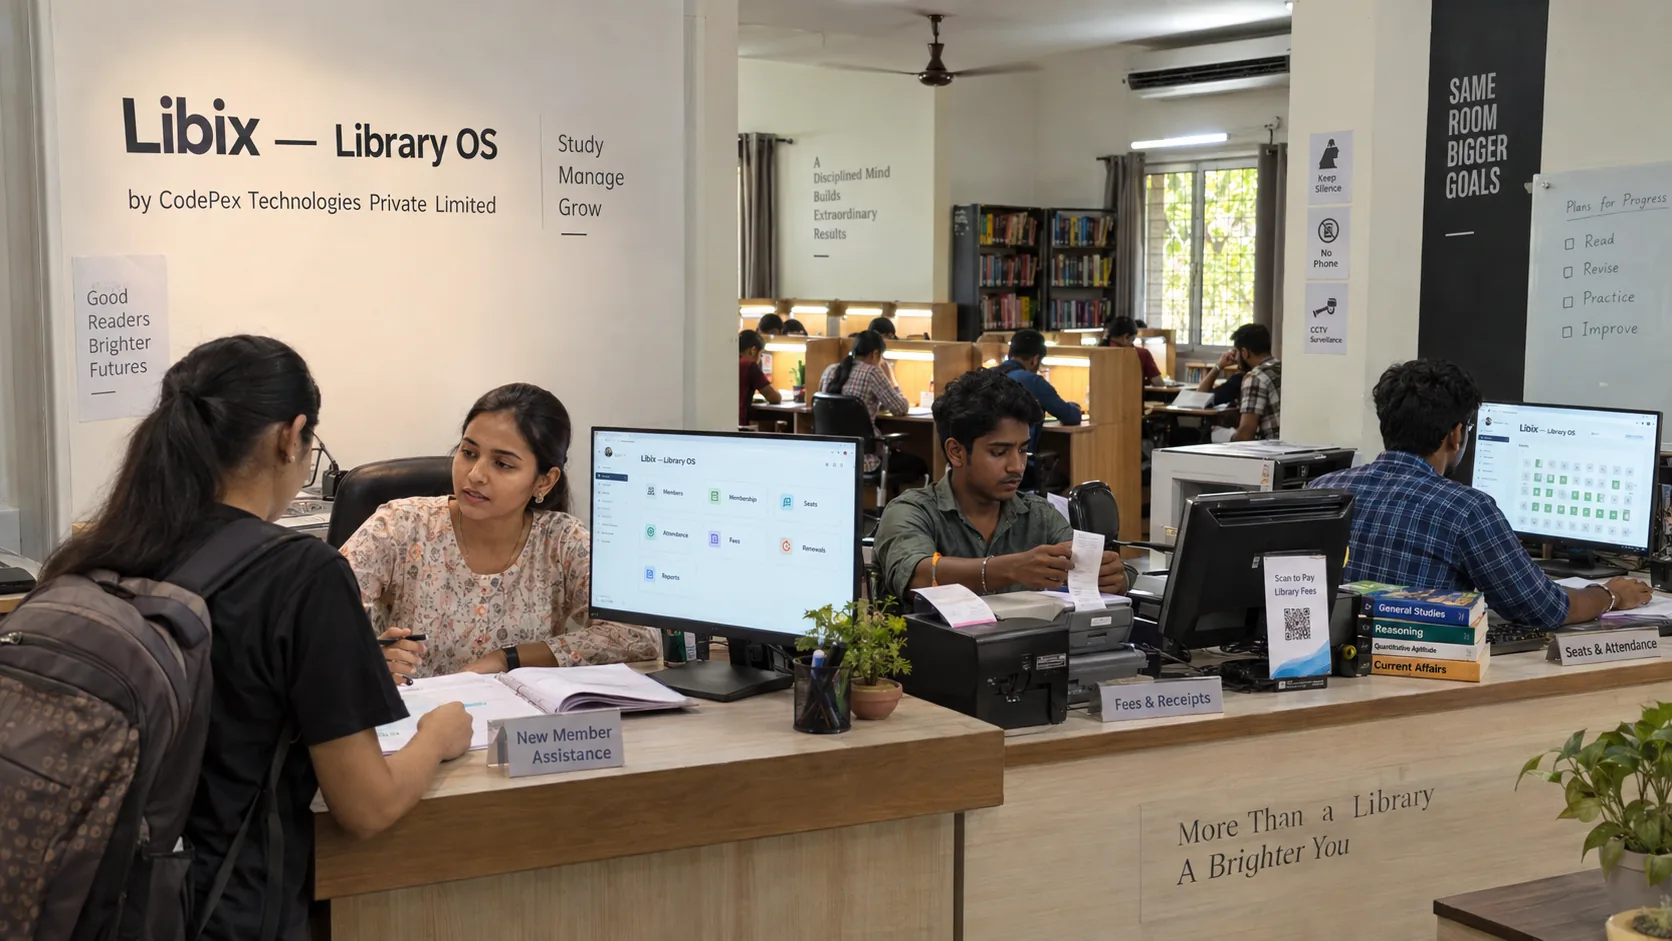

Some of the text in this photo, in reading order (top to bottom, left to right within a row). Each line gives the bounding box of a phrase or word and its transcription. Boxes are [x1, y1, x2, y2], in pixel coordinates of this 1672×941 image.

[1449, 72, 1497, 105] SAME
[1448, 103, 1498, 136] ROOM
[122, 95, 261, 156] Libix
[335, 122, 448, 167] Library
[456, 128, 498, 160] OS
[558, 134, 604, 158] Study
[1447, 134, 1508, 168] BIGGER
[813, 156, 820, 168] A
[558, 165, 625, 190] Manage
[813, 165, 890, 184] Disciplined Mind
[1318, 174, 1337, 183] Keep
[1445, 166, 1501, 199] GOALS
[128, 188, 497, 214] by CodePex Technologies Private Limited
[813, 189, 841, 202] Builds
[1600, 196, 1616, 212] for
[1623, 193, 1668, 210] Progress
[558, 198, 602, 217] Grow
[813, 208, 878, 222] Extraordinary
[813, 228, 847, 240] Results
[1585, 233, 1615, 248] Read
[1320, 249, 1332, 257] No
[1313, 260, 1338, 268] Phone
[1583, 262, 1619, 276] Revise
[87, 288, 128, 306] Good
[1583, 290, 1635, 306] Practice
[88, 312, 150, 330] Readers
[1310, 326, 1328, 334] CCTV
[1582, 321, 1638, 341] Improve
[89, 336, 151, 356] Brighter
[90, 361, 148, 378] Futures
[1519, 424, 1539, 433] Libix
[641, 455, 657, 463] Libix
[663, 457, 685, 466] Library
[686, 458, 696, 466] OS
[803, 500, 818, 508] Seats
[1274, 574, 1292, 582] Scan
[1302, 573, 1315, 583] Pay
[1274, 587, 1317, 597] Library Fees
[1378, 603, 1412, 615] General
[1414, 607, 1446, 619] Studies
[1375, 624, 1424, 638] Reasoning
[1565, 639, 1658, 658] Seats & Attendance
[1374, 660, 1447, 674] Current Affairs
[1115, 692, 1212, 711] Fees & Receipts
[516, 726, 613, 745] New Member
[532, 748, 612, 765] Assistance
[1178, 787, 1435, 847] More Than a Library
[1176, 835, 1350, 886] A Brighter You
